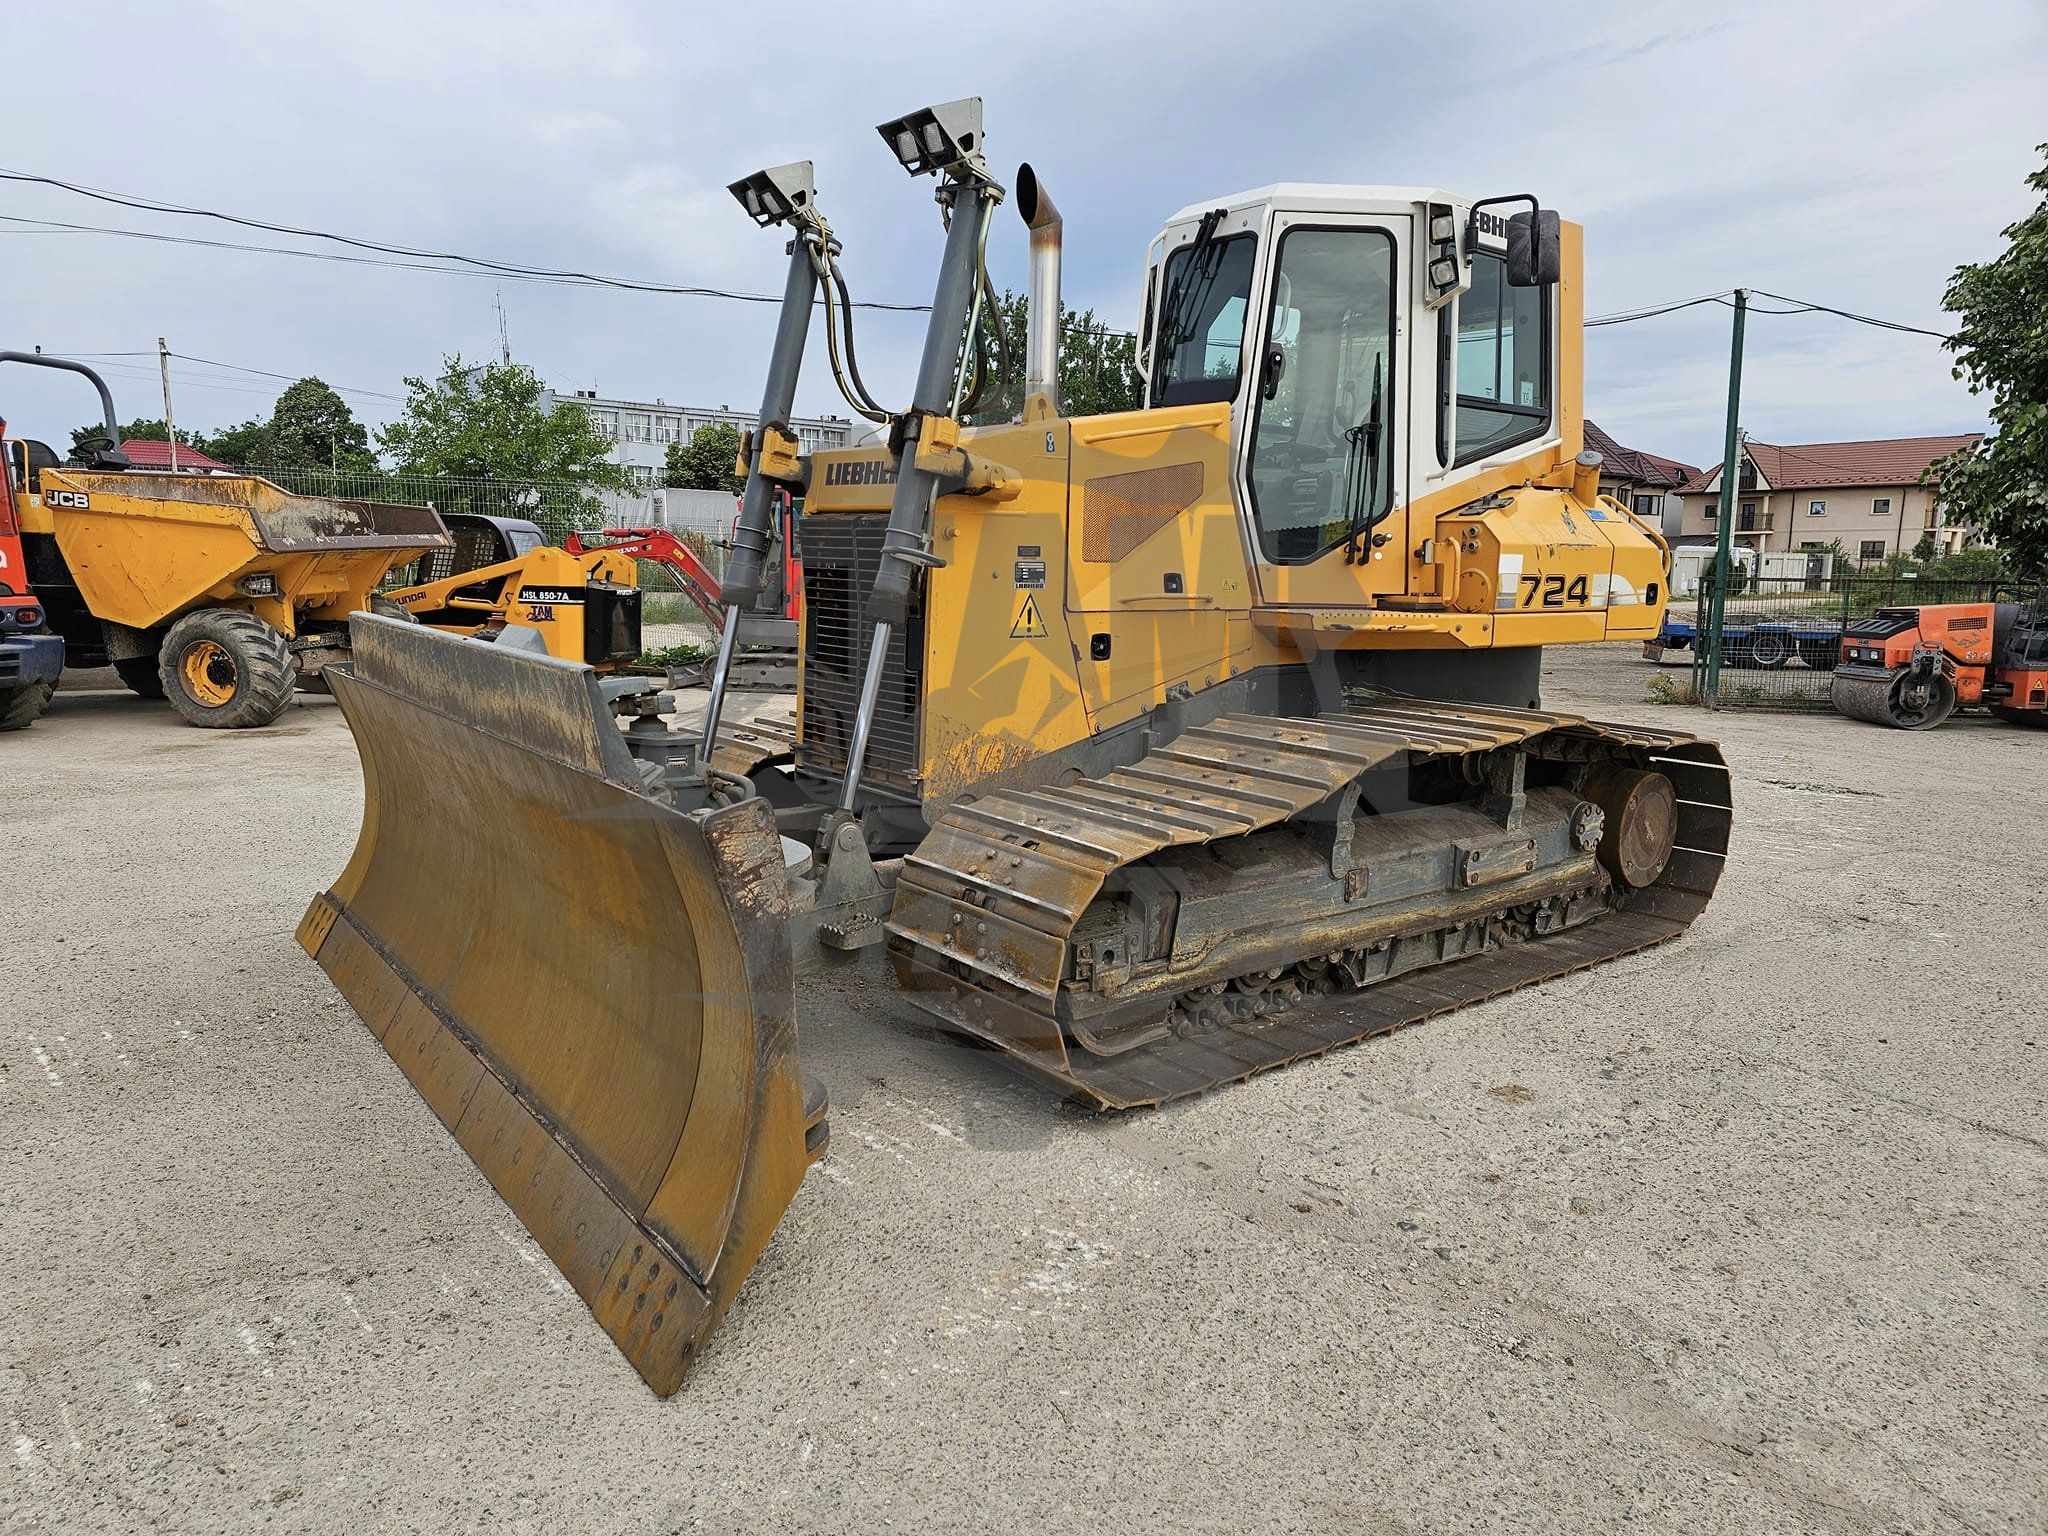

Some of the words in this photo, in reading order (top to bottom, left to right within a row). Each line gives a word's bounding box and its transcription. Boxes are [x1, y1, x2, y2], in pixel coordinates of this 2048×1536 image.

[47, 491, 89, 508] JCB
[617, 546, 638, 554] LVO
[394, 591, 427, 605] UNDAI
[522, 591, 538, 600] HSL
[539, 591, 569, 600] 850-7A
[1520, 574, 1589, 608] 724
